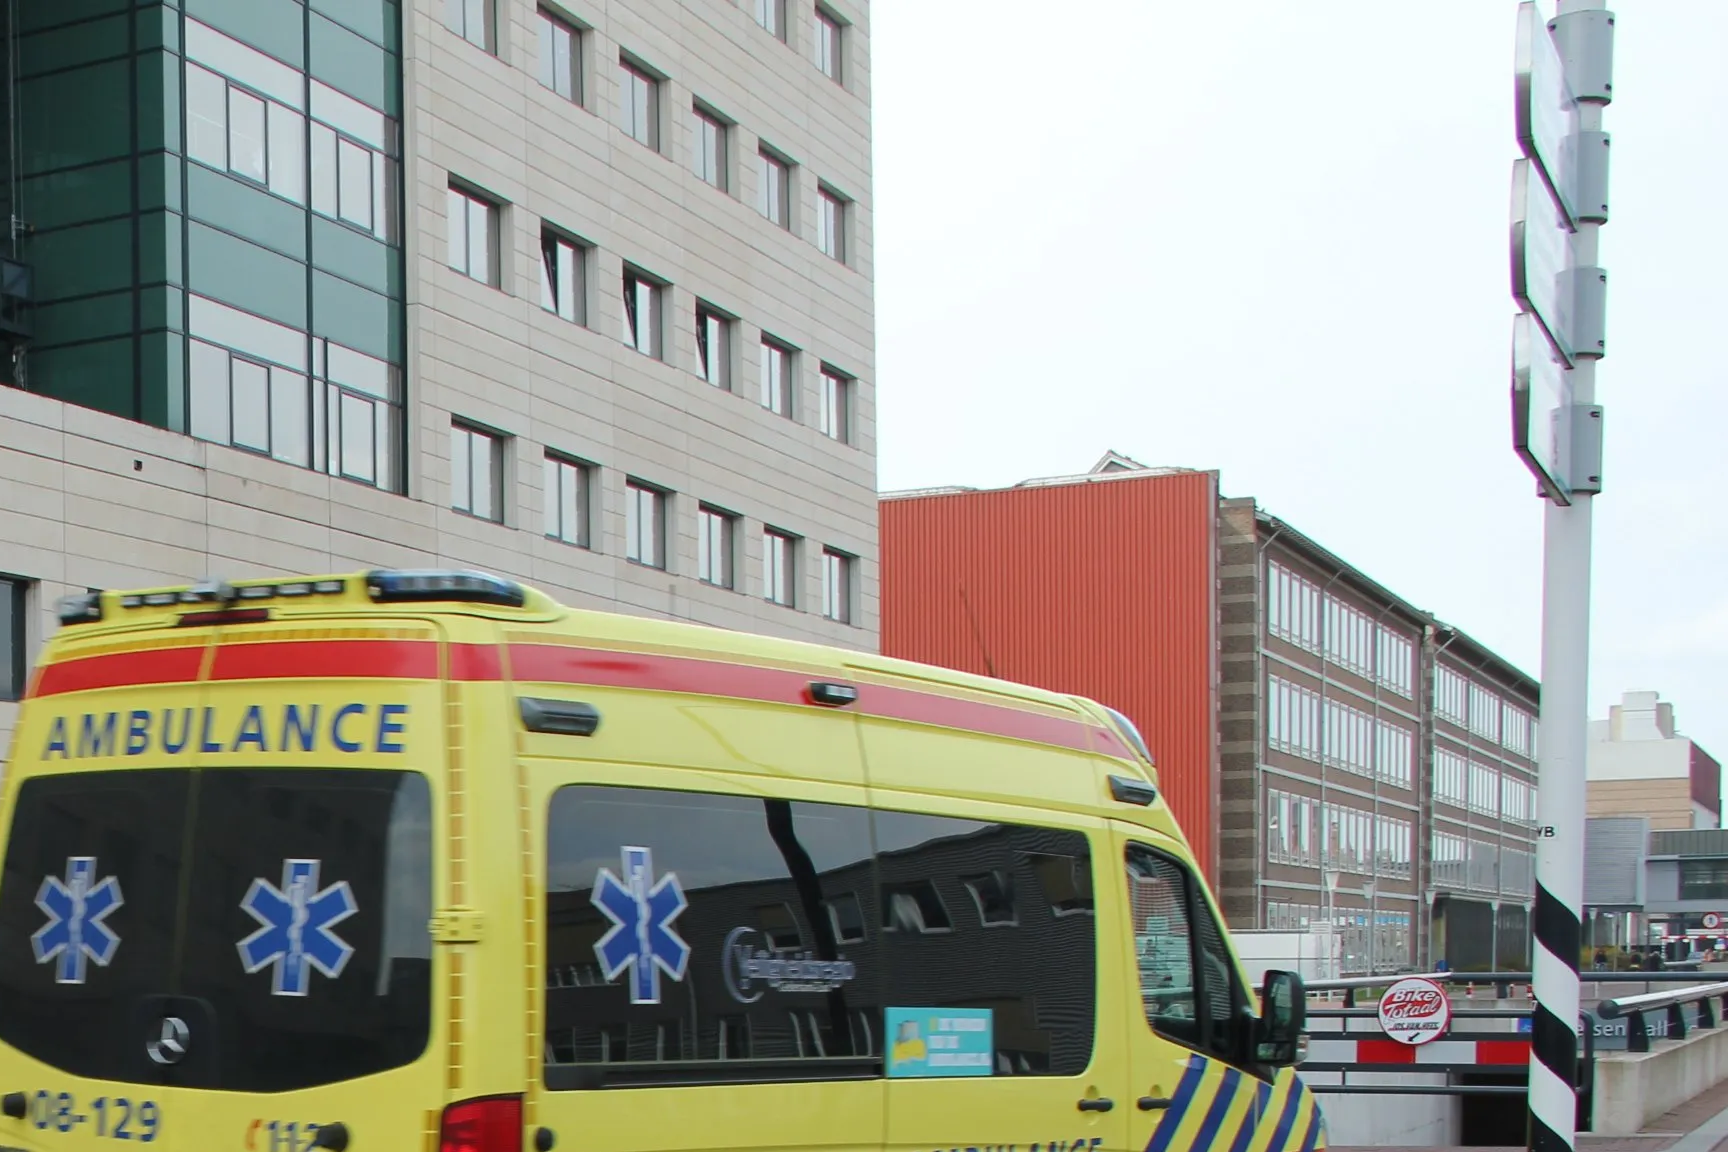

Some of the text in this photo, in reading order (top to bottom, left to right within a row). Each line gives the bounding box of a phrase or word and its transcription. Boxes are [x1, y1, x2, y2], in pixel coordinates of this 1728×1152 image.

[42, 703, 411, 760] AMBULANCE
[1384, 996, 1441, 1019] Totaal
[1392, 989, 1436, 1002] Bike
[32, 1089, 161, 1142] 08-129
